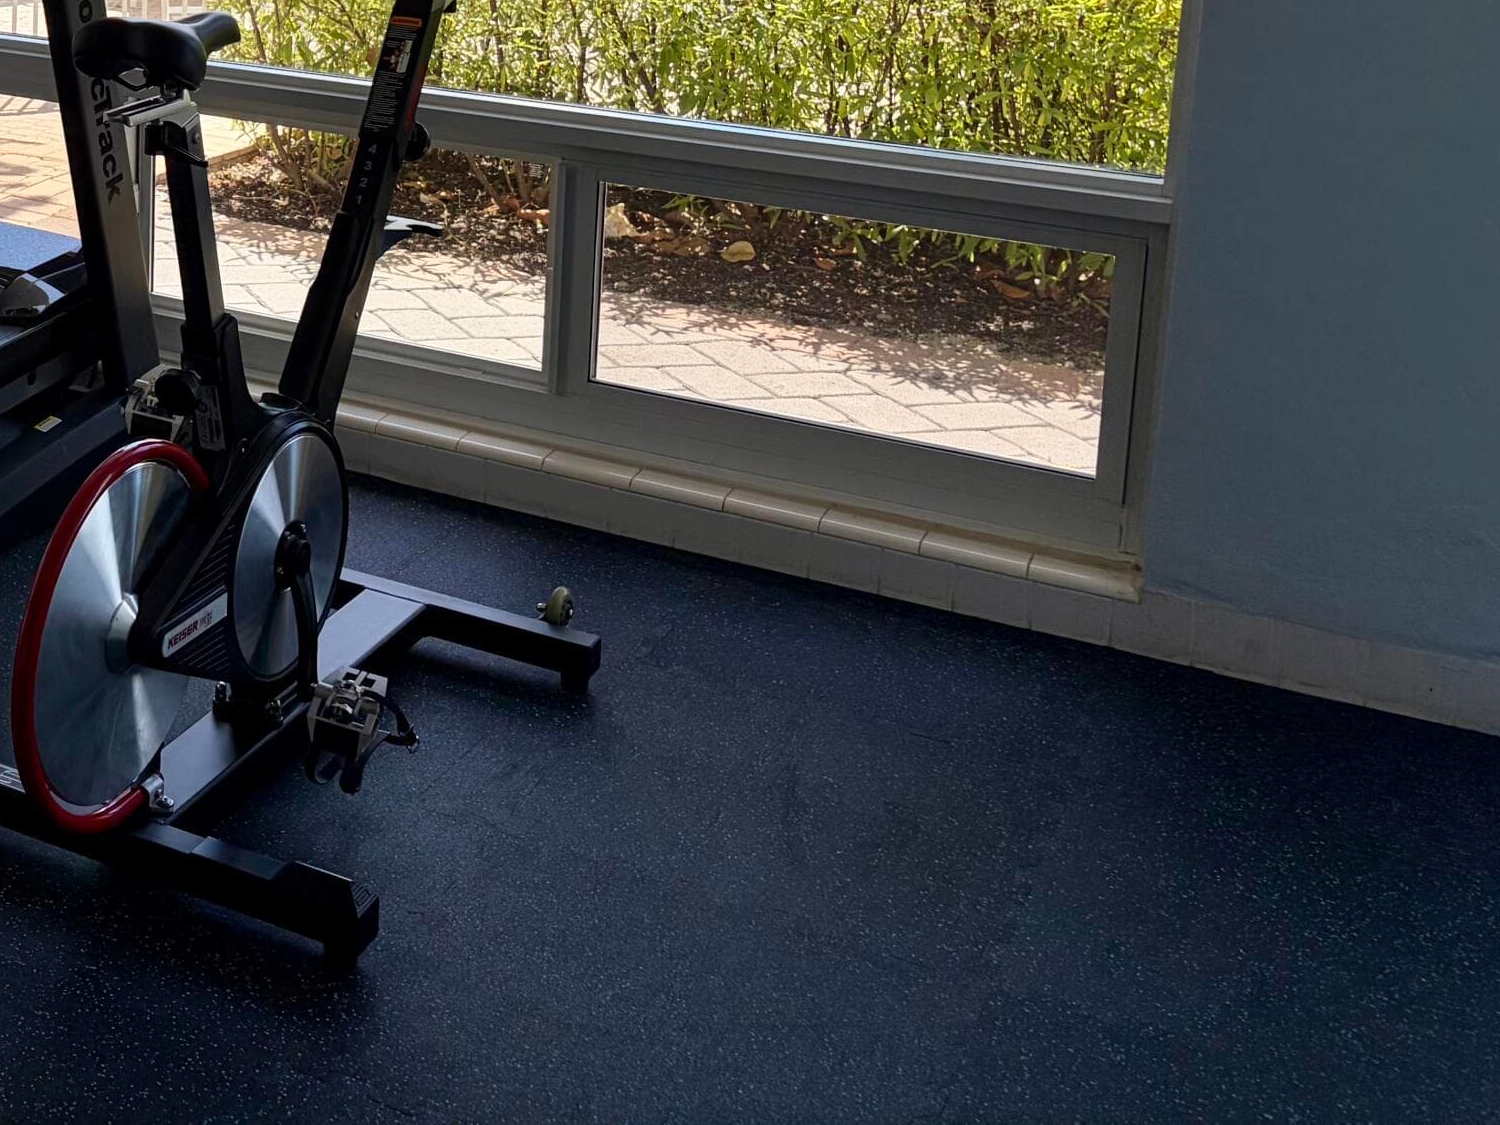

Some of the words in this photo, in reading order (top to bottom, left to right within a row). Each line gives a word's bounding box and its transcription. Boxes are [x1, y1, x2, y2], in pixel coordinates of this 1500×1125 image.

[368, 143, 378, 154] 4
[363, 161, 373, 172] 3
[358, 177, 368, 188] 2
[355, 194, 363, 206] 1
[167, 620, 199, 650] KEISER
